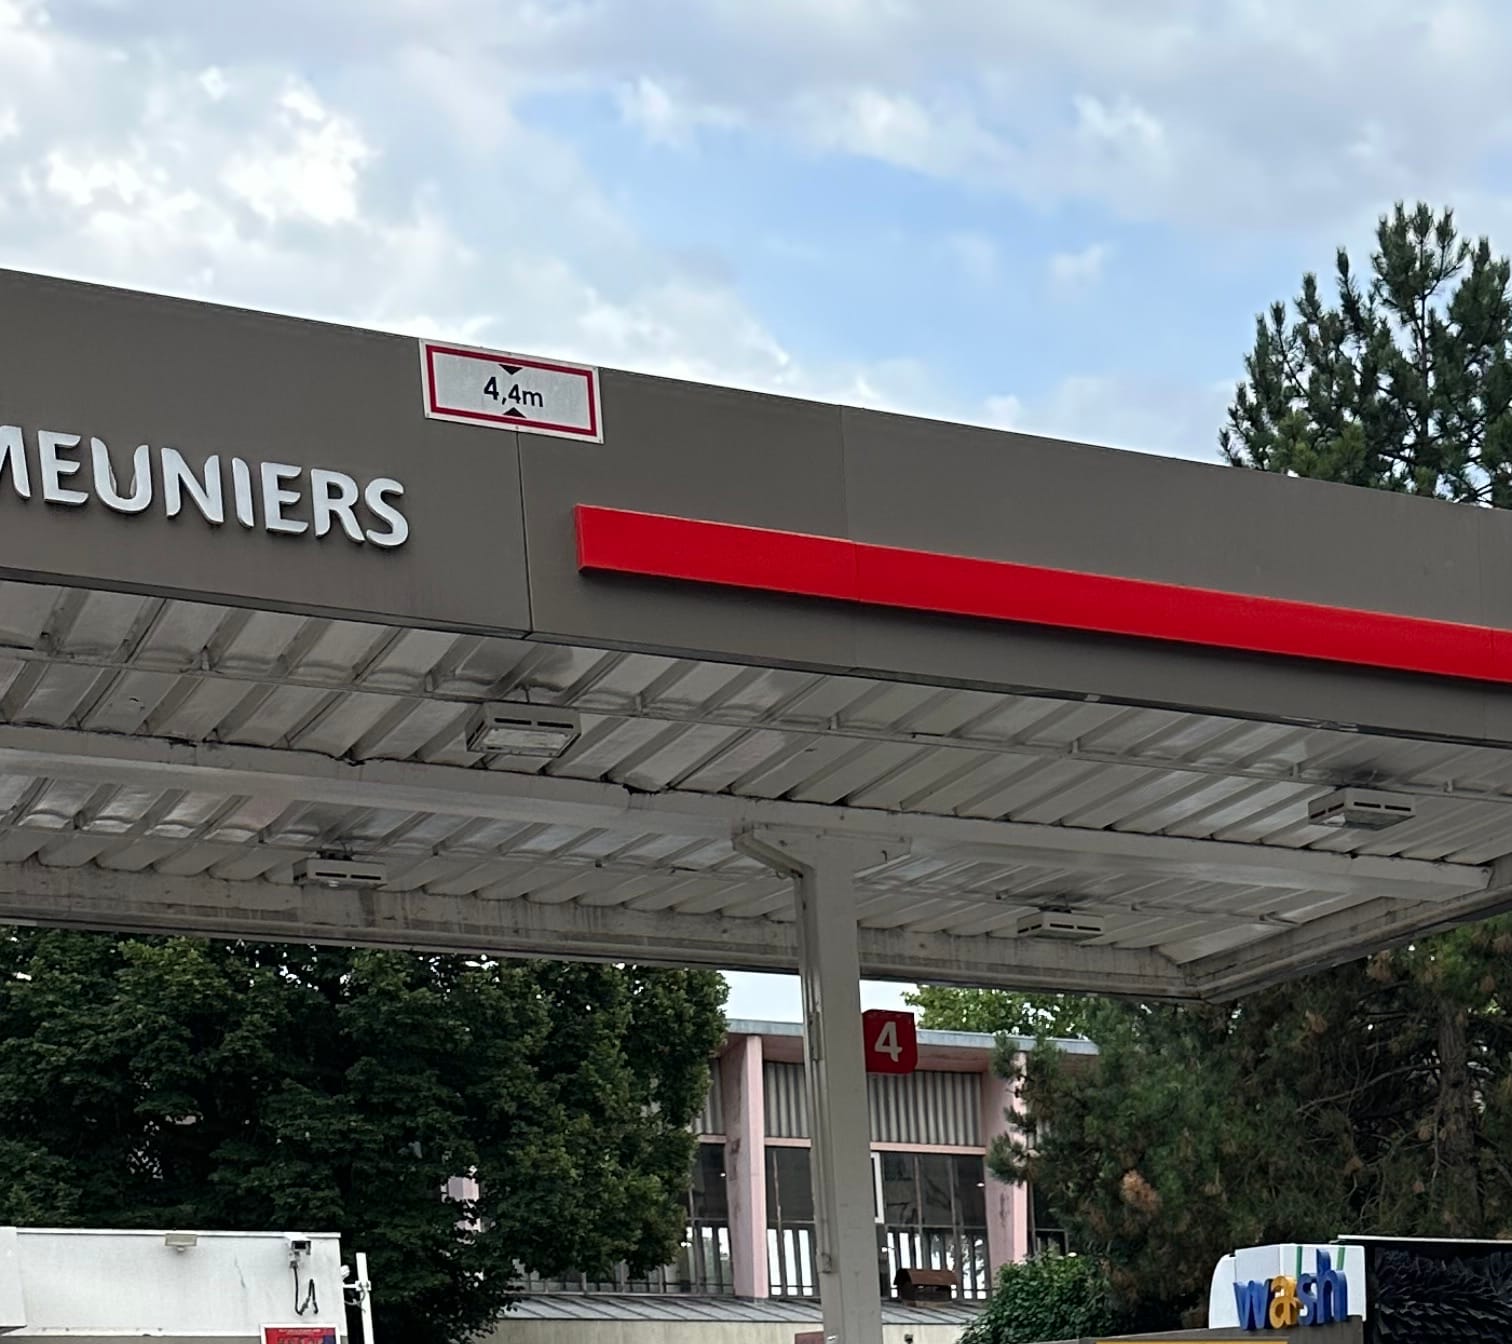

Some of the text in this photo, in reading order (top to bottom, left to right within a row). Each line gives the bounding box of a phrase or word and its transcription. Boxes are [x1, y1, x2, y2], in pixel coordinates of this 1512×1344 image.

[483, 376, 544, 408] 4,4m
[874, 1021, 902, 1063] 4
[1233, 1248, 1348, 1331] wash
